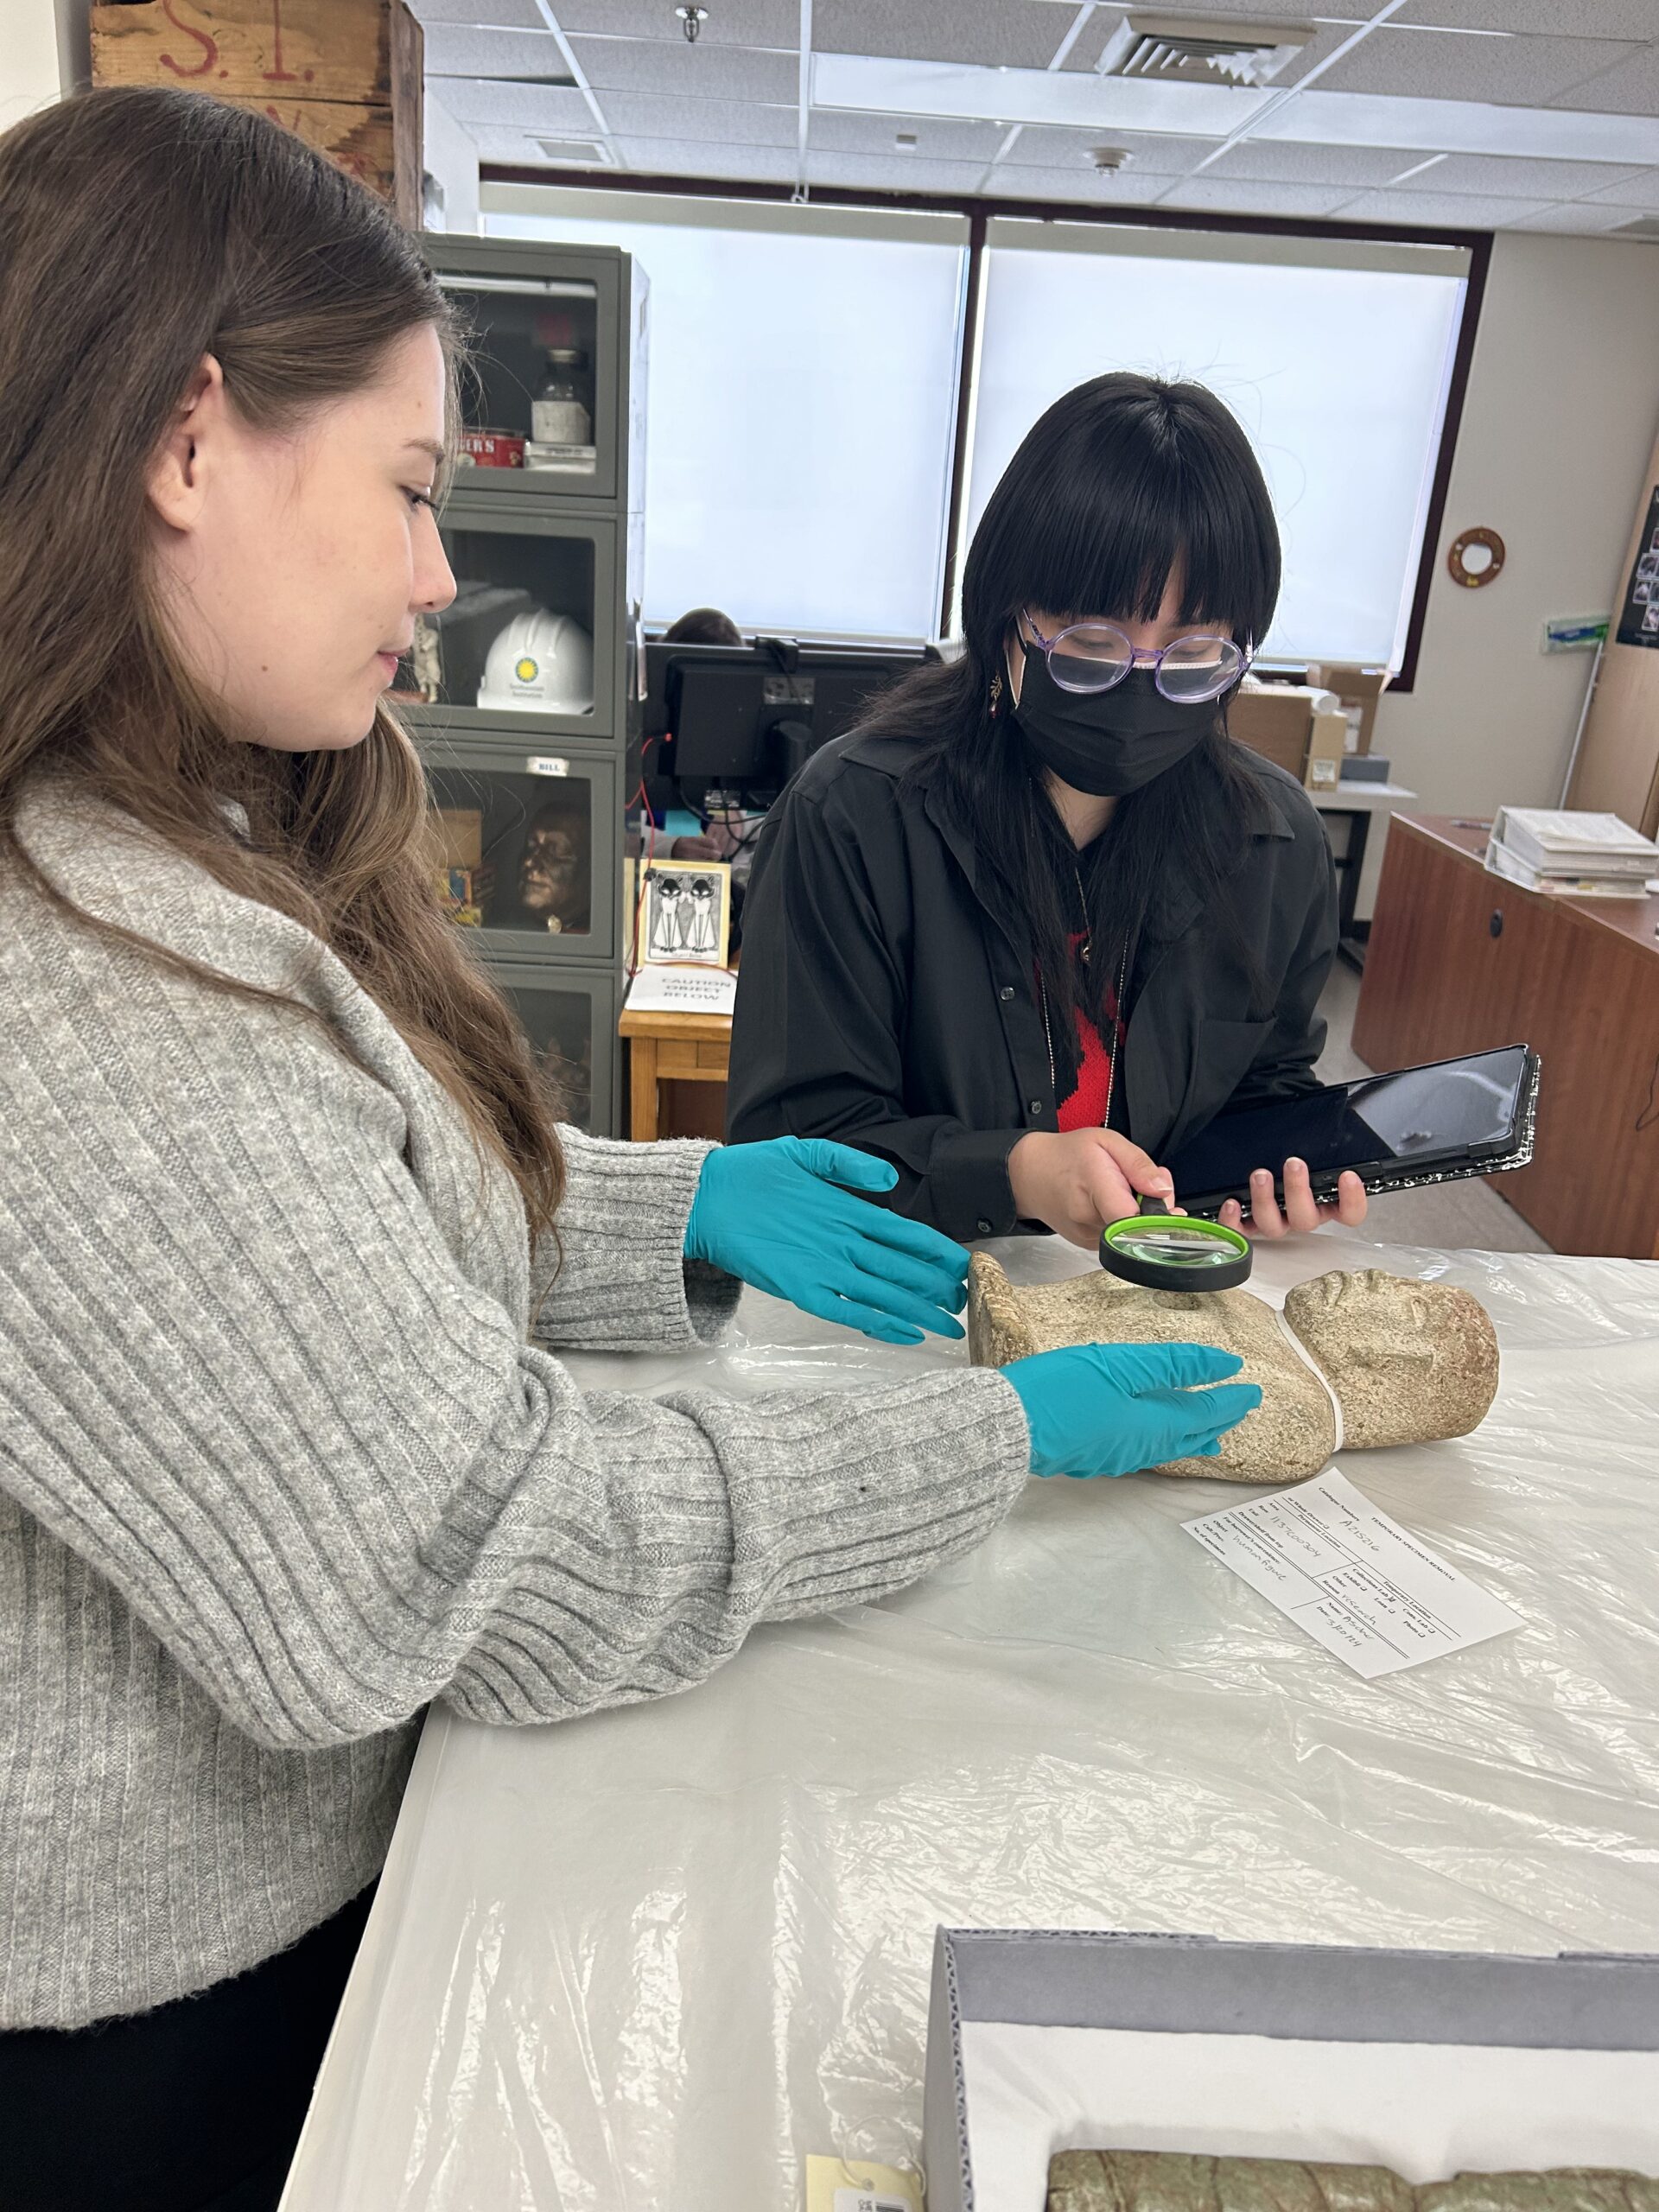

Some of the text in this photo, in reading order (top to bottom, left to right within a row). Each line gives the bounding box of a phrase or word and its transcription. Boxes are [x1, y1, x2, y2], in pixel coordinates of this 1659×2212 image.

[538, 763, 561, 772] BILL
[662, 978, 731, 987] CAUTION
[663, 992, 719, 1001] BELOW
[1212, 1520, 1228, 1532] Object
[1320, 1532, 1340, 1548] Location
[1370, 1516, 1455, 1580] TEMPORARY SPECIMEN REMOVAL
[1332, 1575, 1347, 1586] Other
[1342, 1572, 1361, 1586] Exhibit
[1352, 1568, 1378, 1589] Collections
[1322, 1580, 1339, 1594] Reason
[1374, 1597, 1387, 1608] Loan
[1383, 1580, 1431, 1618] Temporary Location
[1402, 1620, 1418, 1633] Photo
